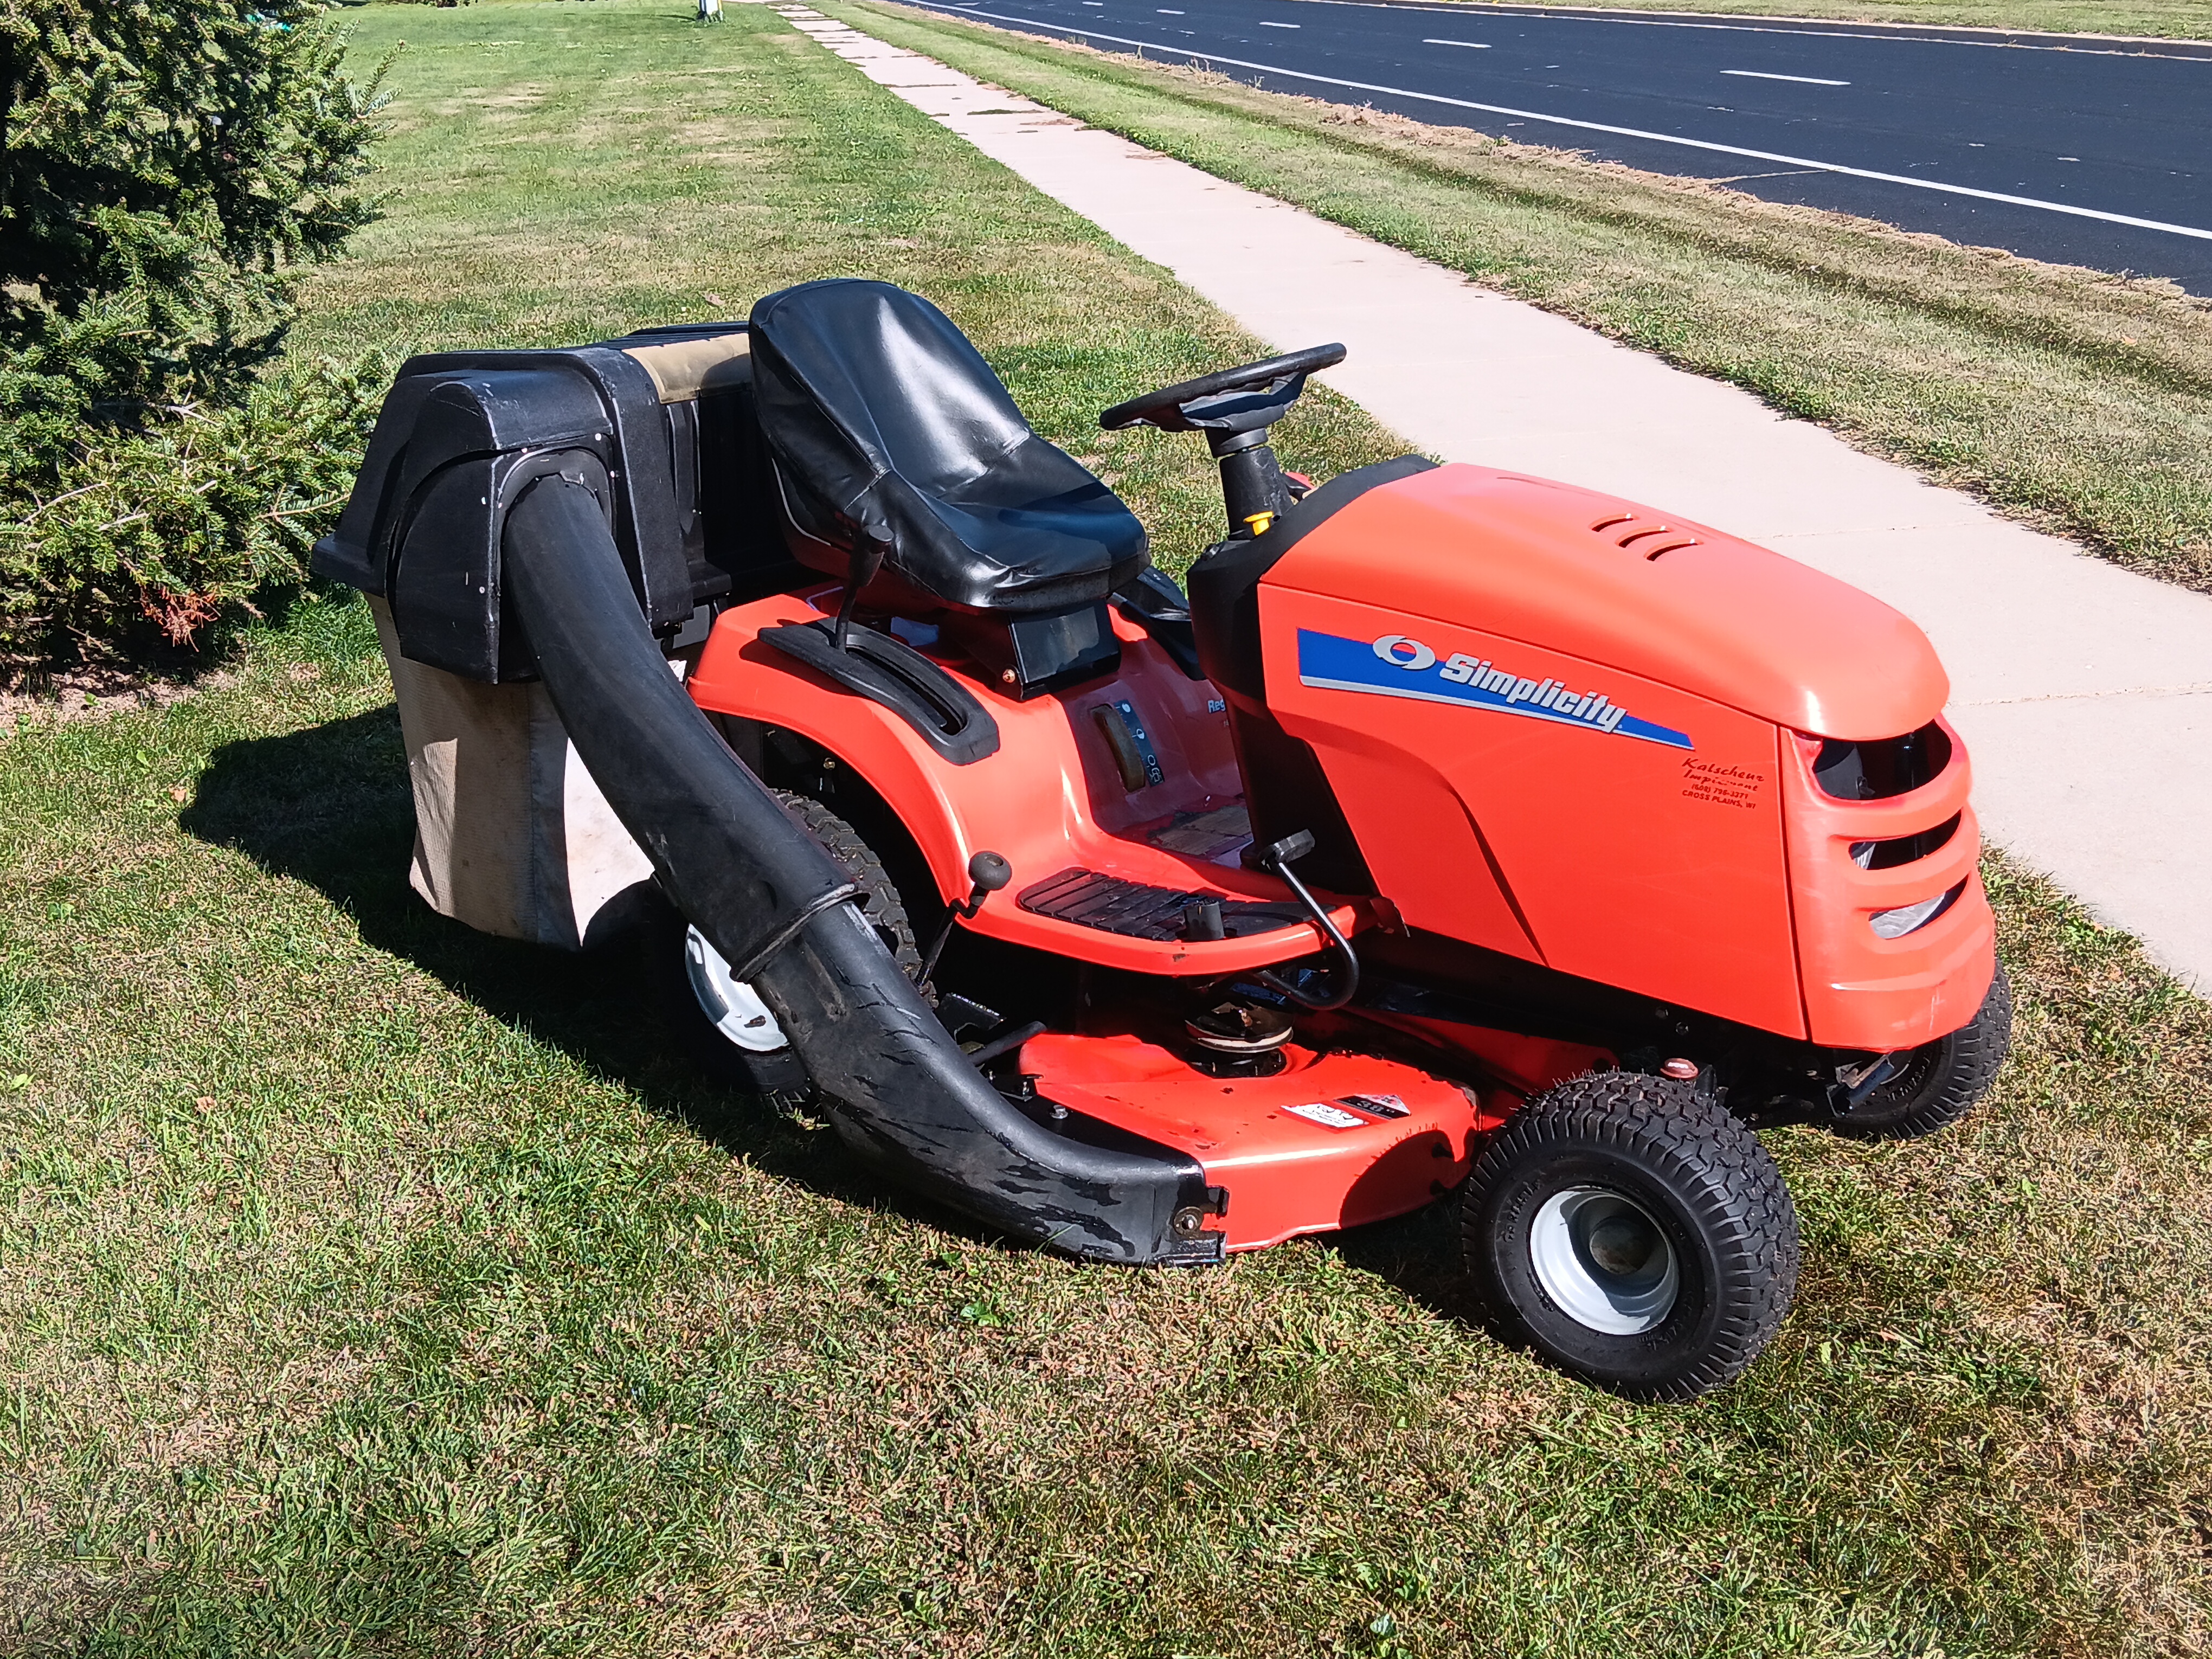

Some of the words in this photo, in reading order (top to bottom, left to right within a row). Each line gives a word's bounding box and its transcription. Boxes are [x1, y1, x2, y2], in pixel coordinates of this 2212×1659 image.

[1439, 652, 1628, 733] Simplicity
[1682, 790, 1710, 800] CROSS
[1712, 796, 1742, 808] PLAINS,
